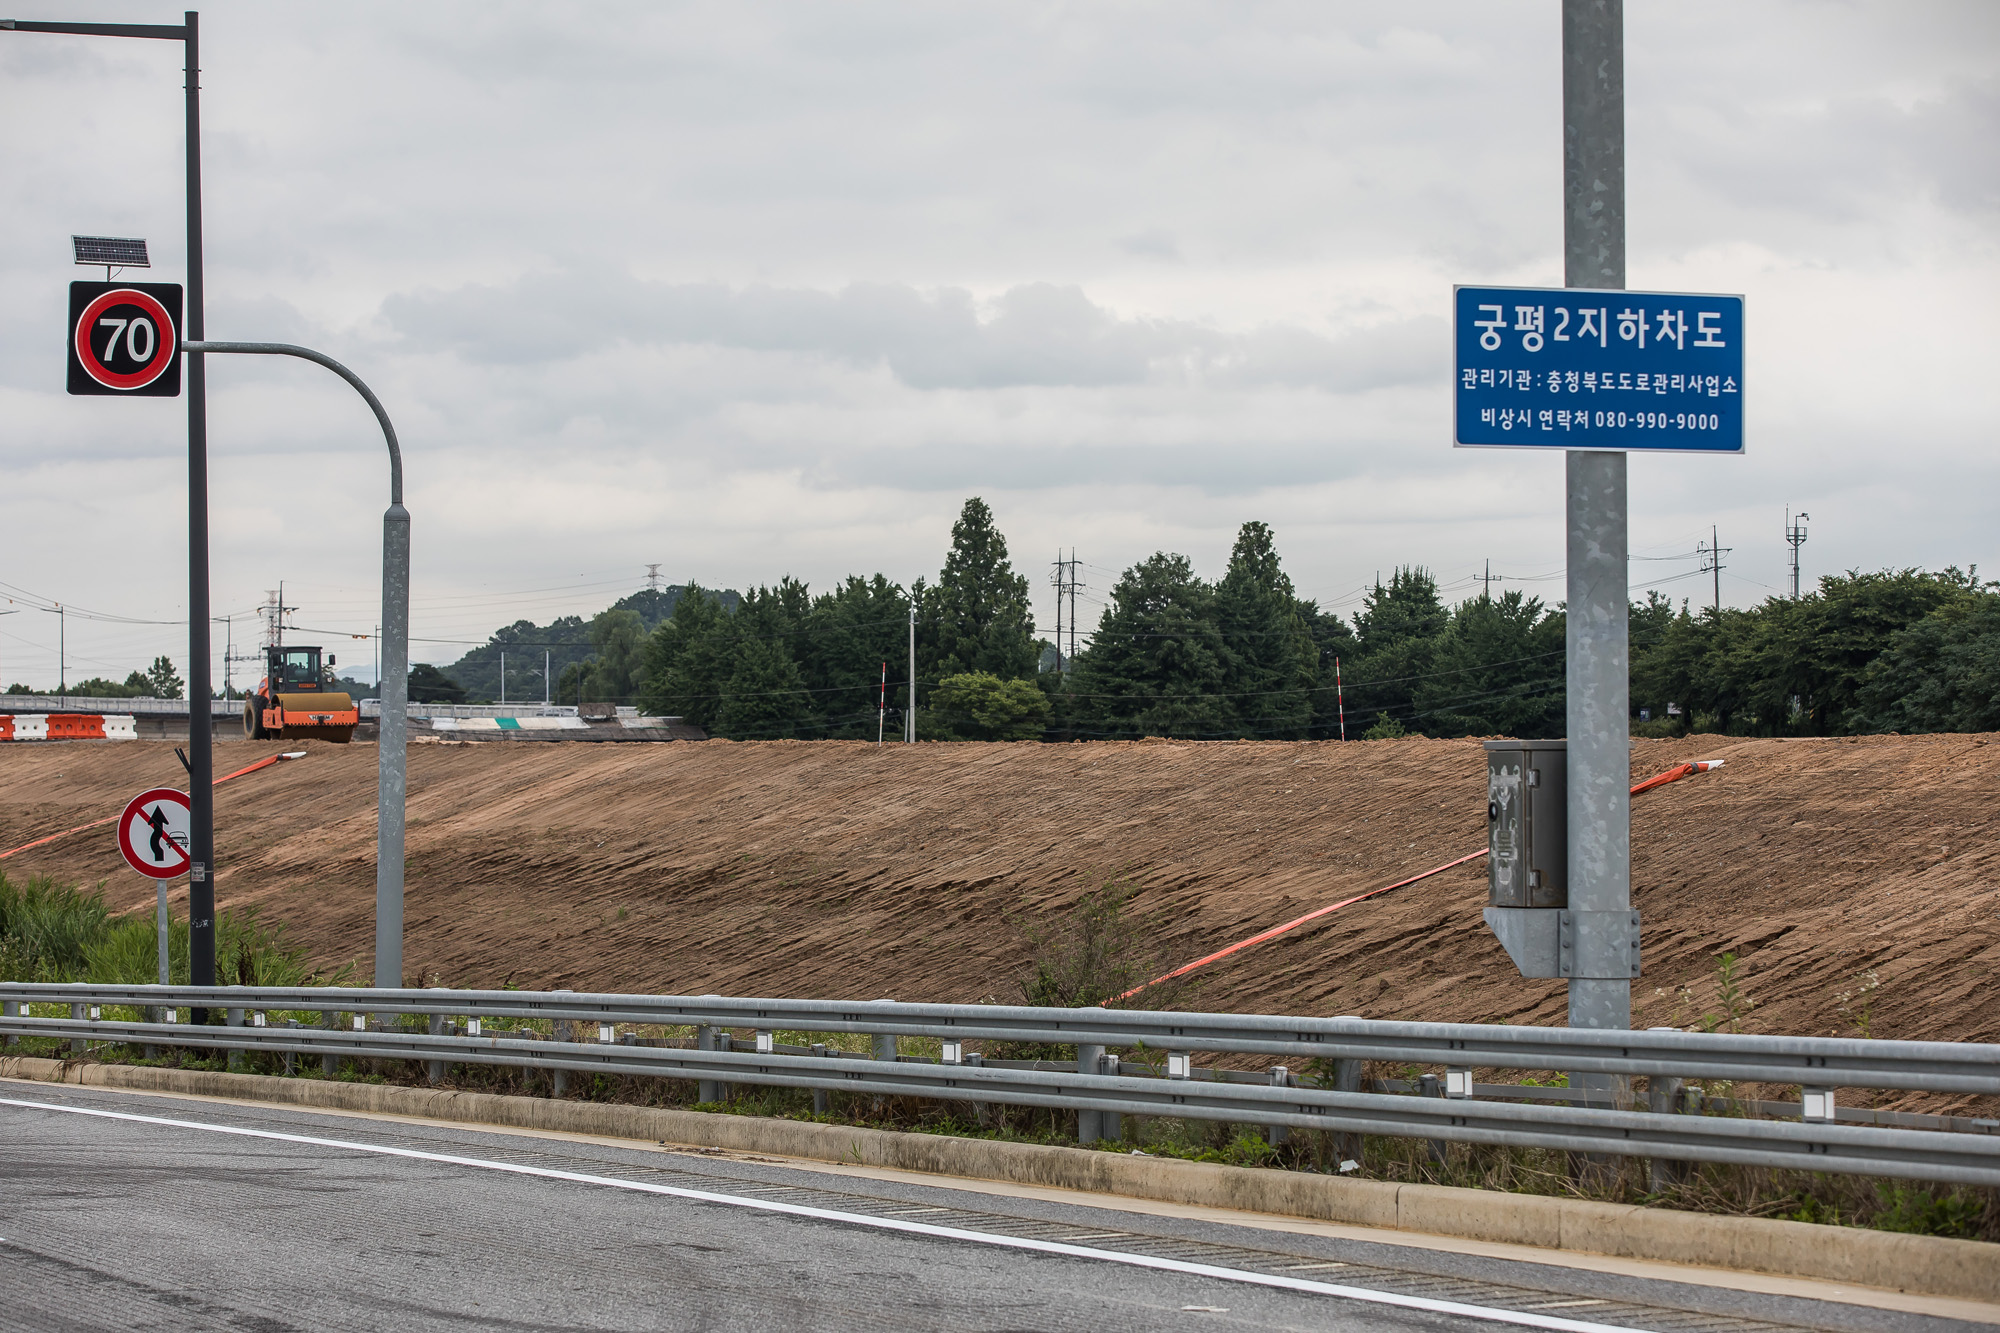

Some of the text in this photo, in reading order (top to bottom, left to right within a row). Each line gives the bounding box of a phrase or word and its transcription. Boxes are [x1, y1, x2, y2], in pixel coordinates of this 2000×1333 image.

[99, 316, 155, 363] 70
[1474, 304, 1726, 353] 궁평2지하차도
[1481, 408, 1719, 431] 비상시 연락처 080-990-9000
